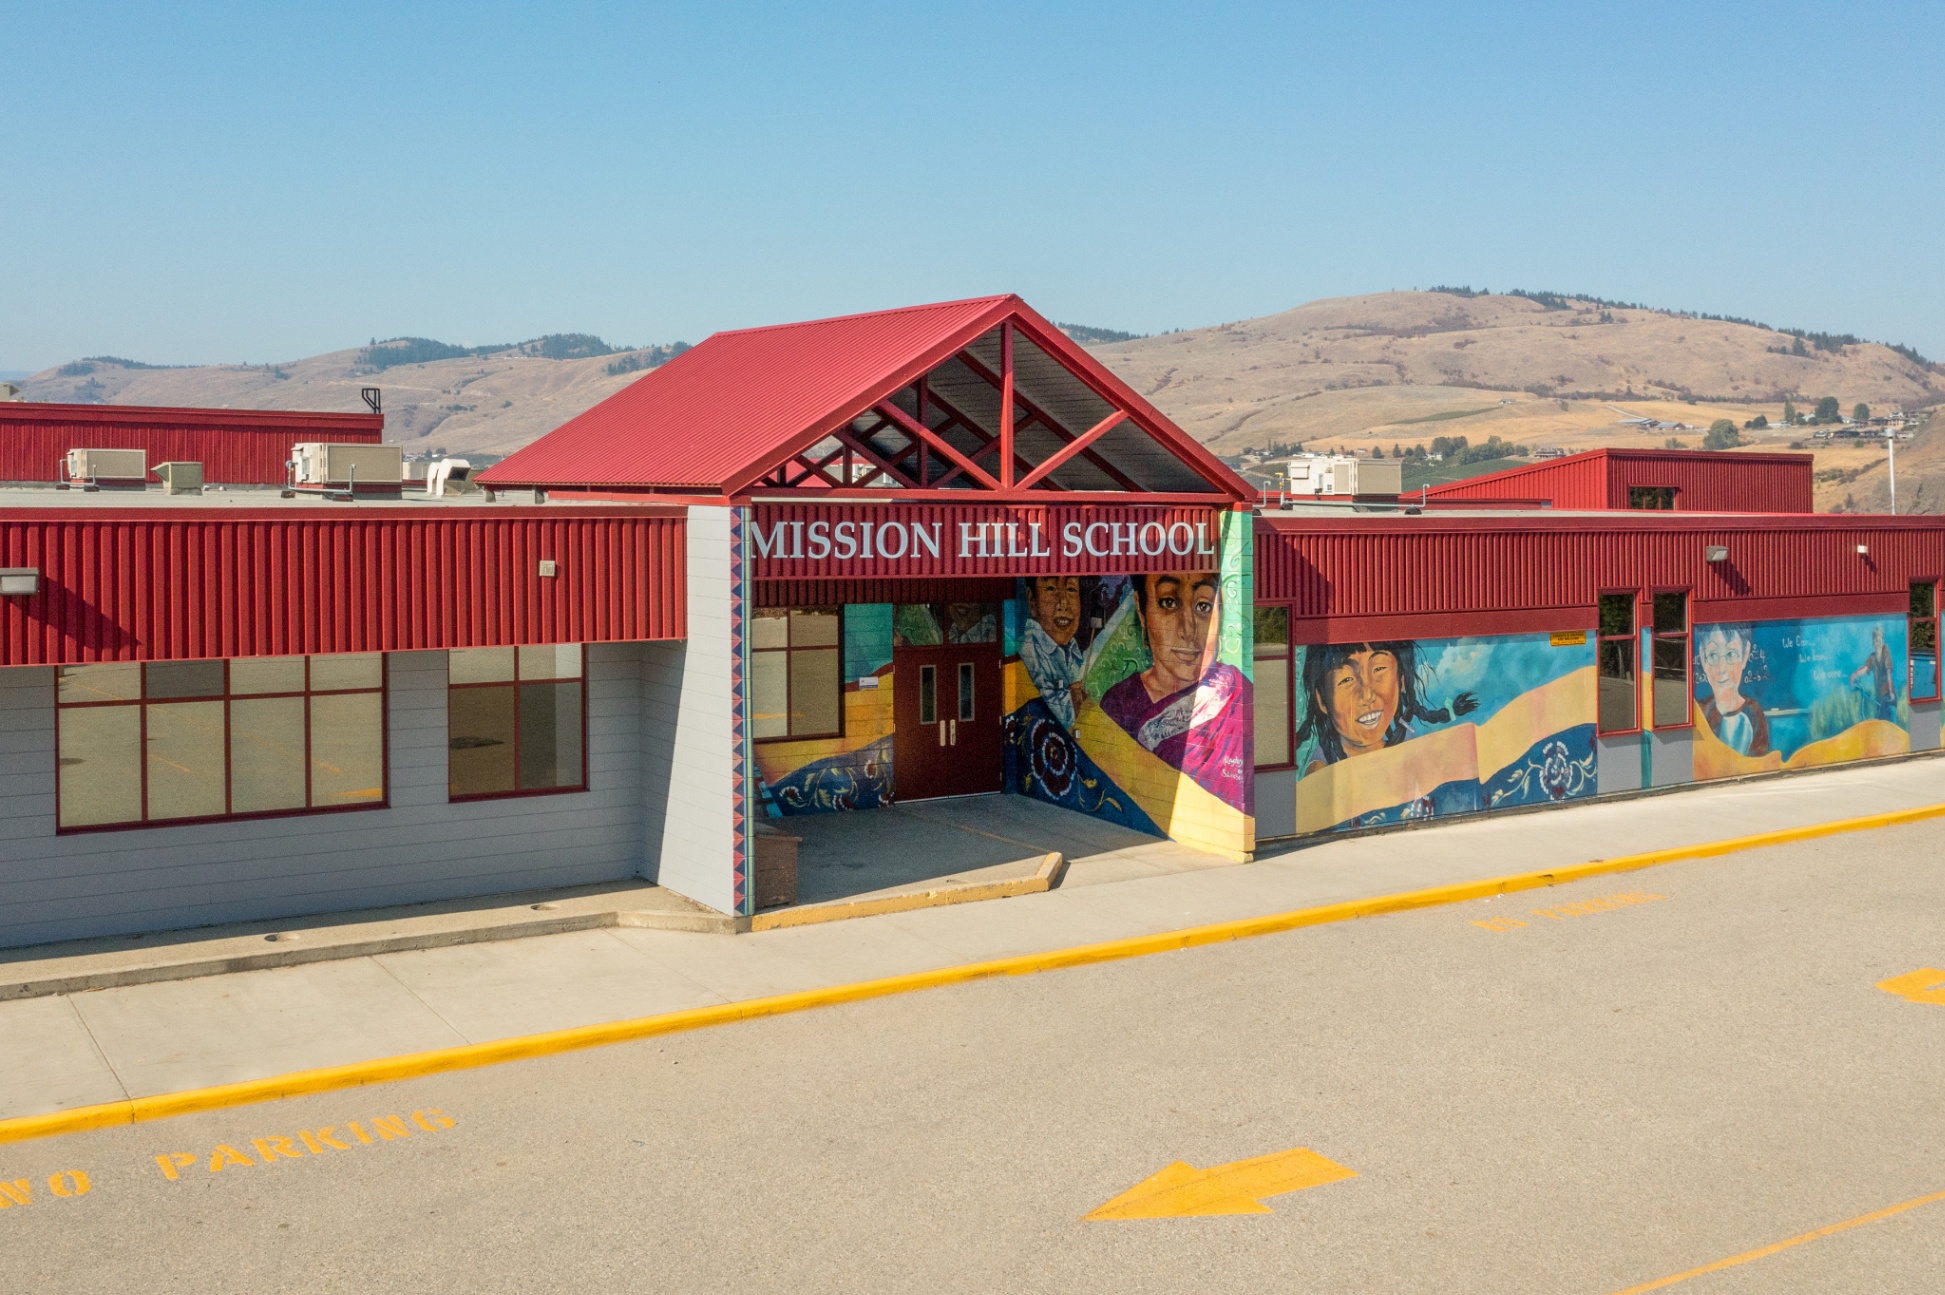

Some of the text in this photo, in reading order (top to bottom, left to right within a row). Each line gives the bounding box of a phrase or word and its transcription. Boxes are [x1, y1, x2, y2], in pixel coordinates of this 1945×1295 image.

[750, 521, 1215, 560] MISSION HILL SCHOOL
[1781, 637, 1794, 649] We
[0, 1108, 456, 1210] NO PARKING
